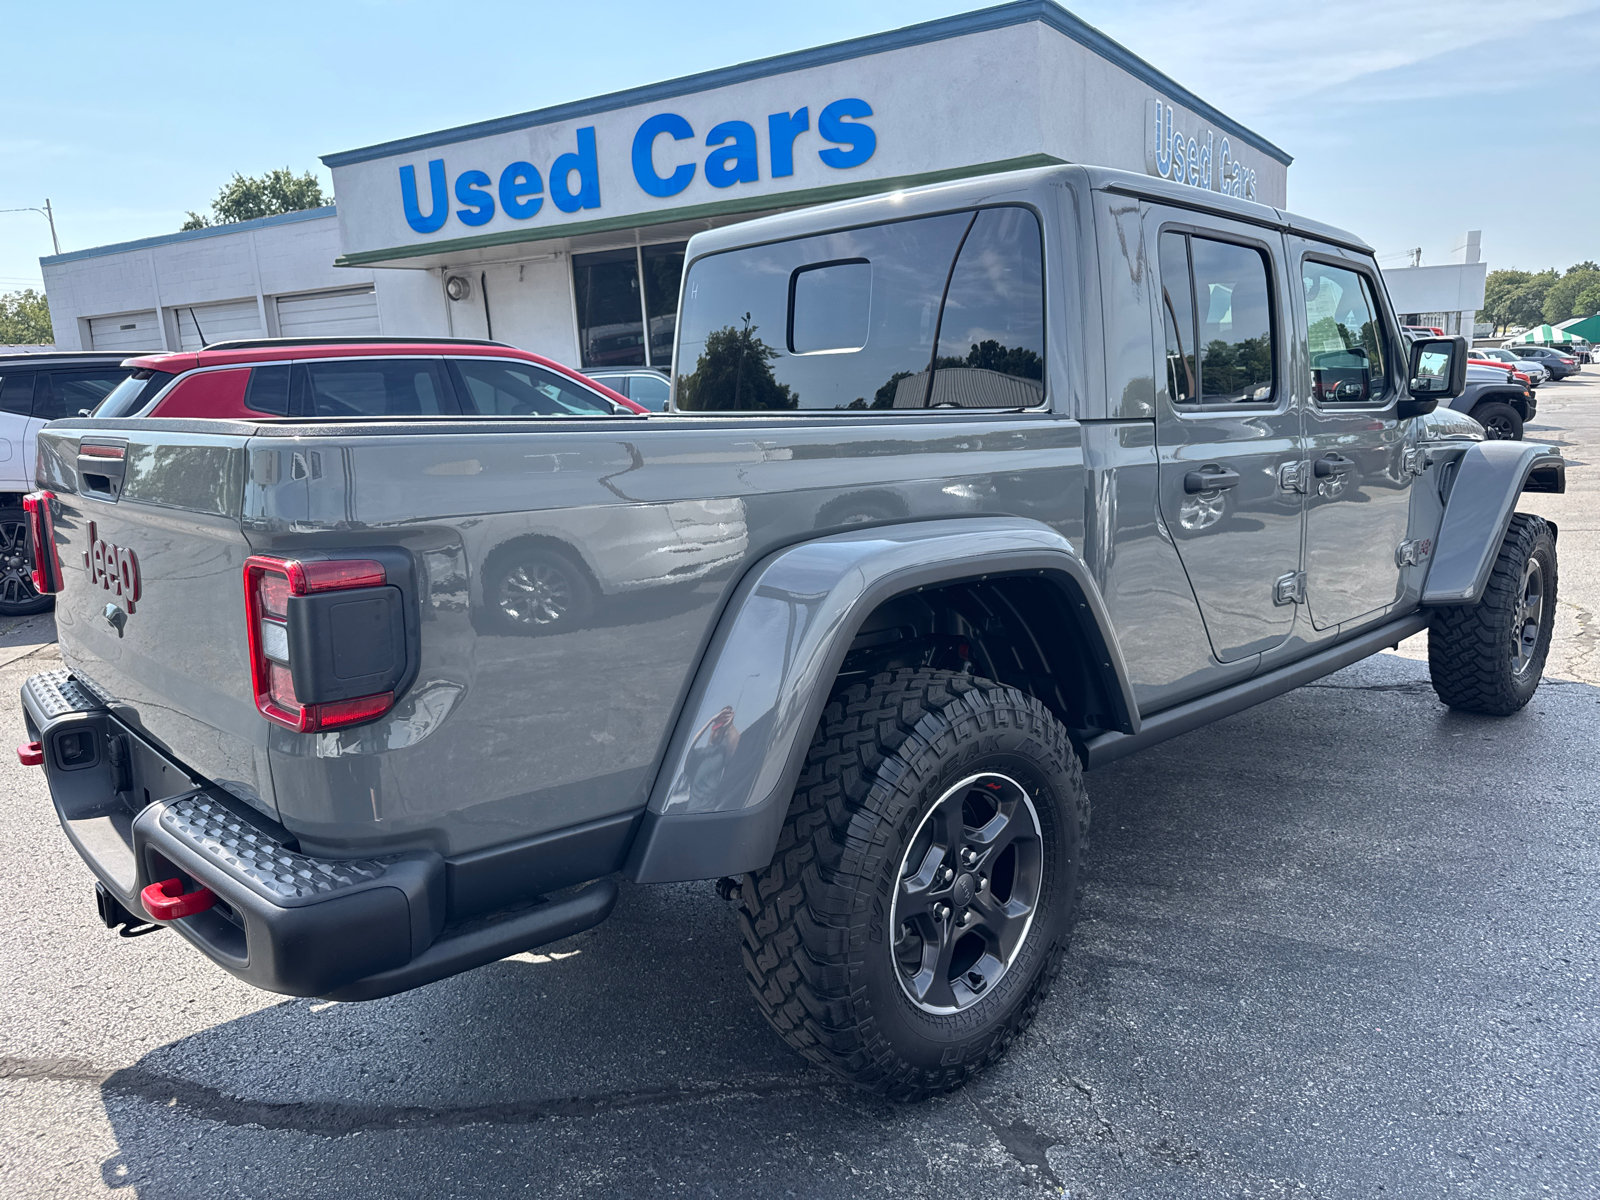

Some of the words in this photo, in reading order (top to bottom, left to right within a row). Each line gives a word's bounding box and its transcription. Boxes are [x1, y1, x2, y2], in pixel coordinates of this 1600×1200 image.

[398, 125, 602, 234] Used
[631, 98, 878, 198] Cars
[1155, 98, 1214, 192] Used
[1219, 136, 1257, 203] Cars
[81, 520, 143, 615] Jeep
